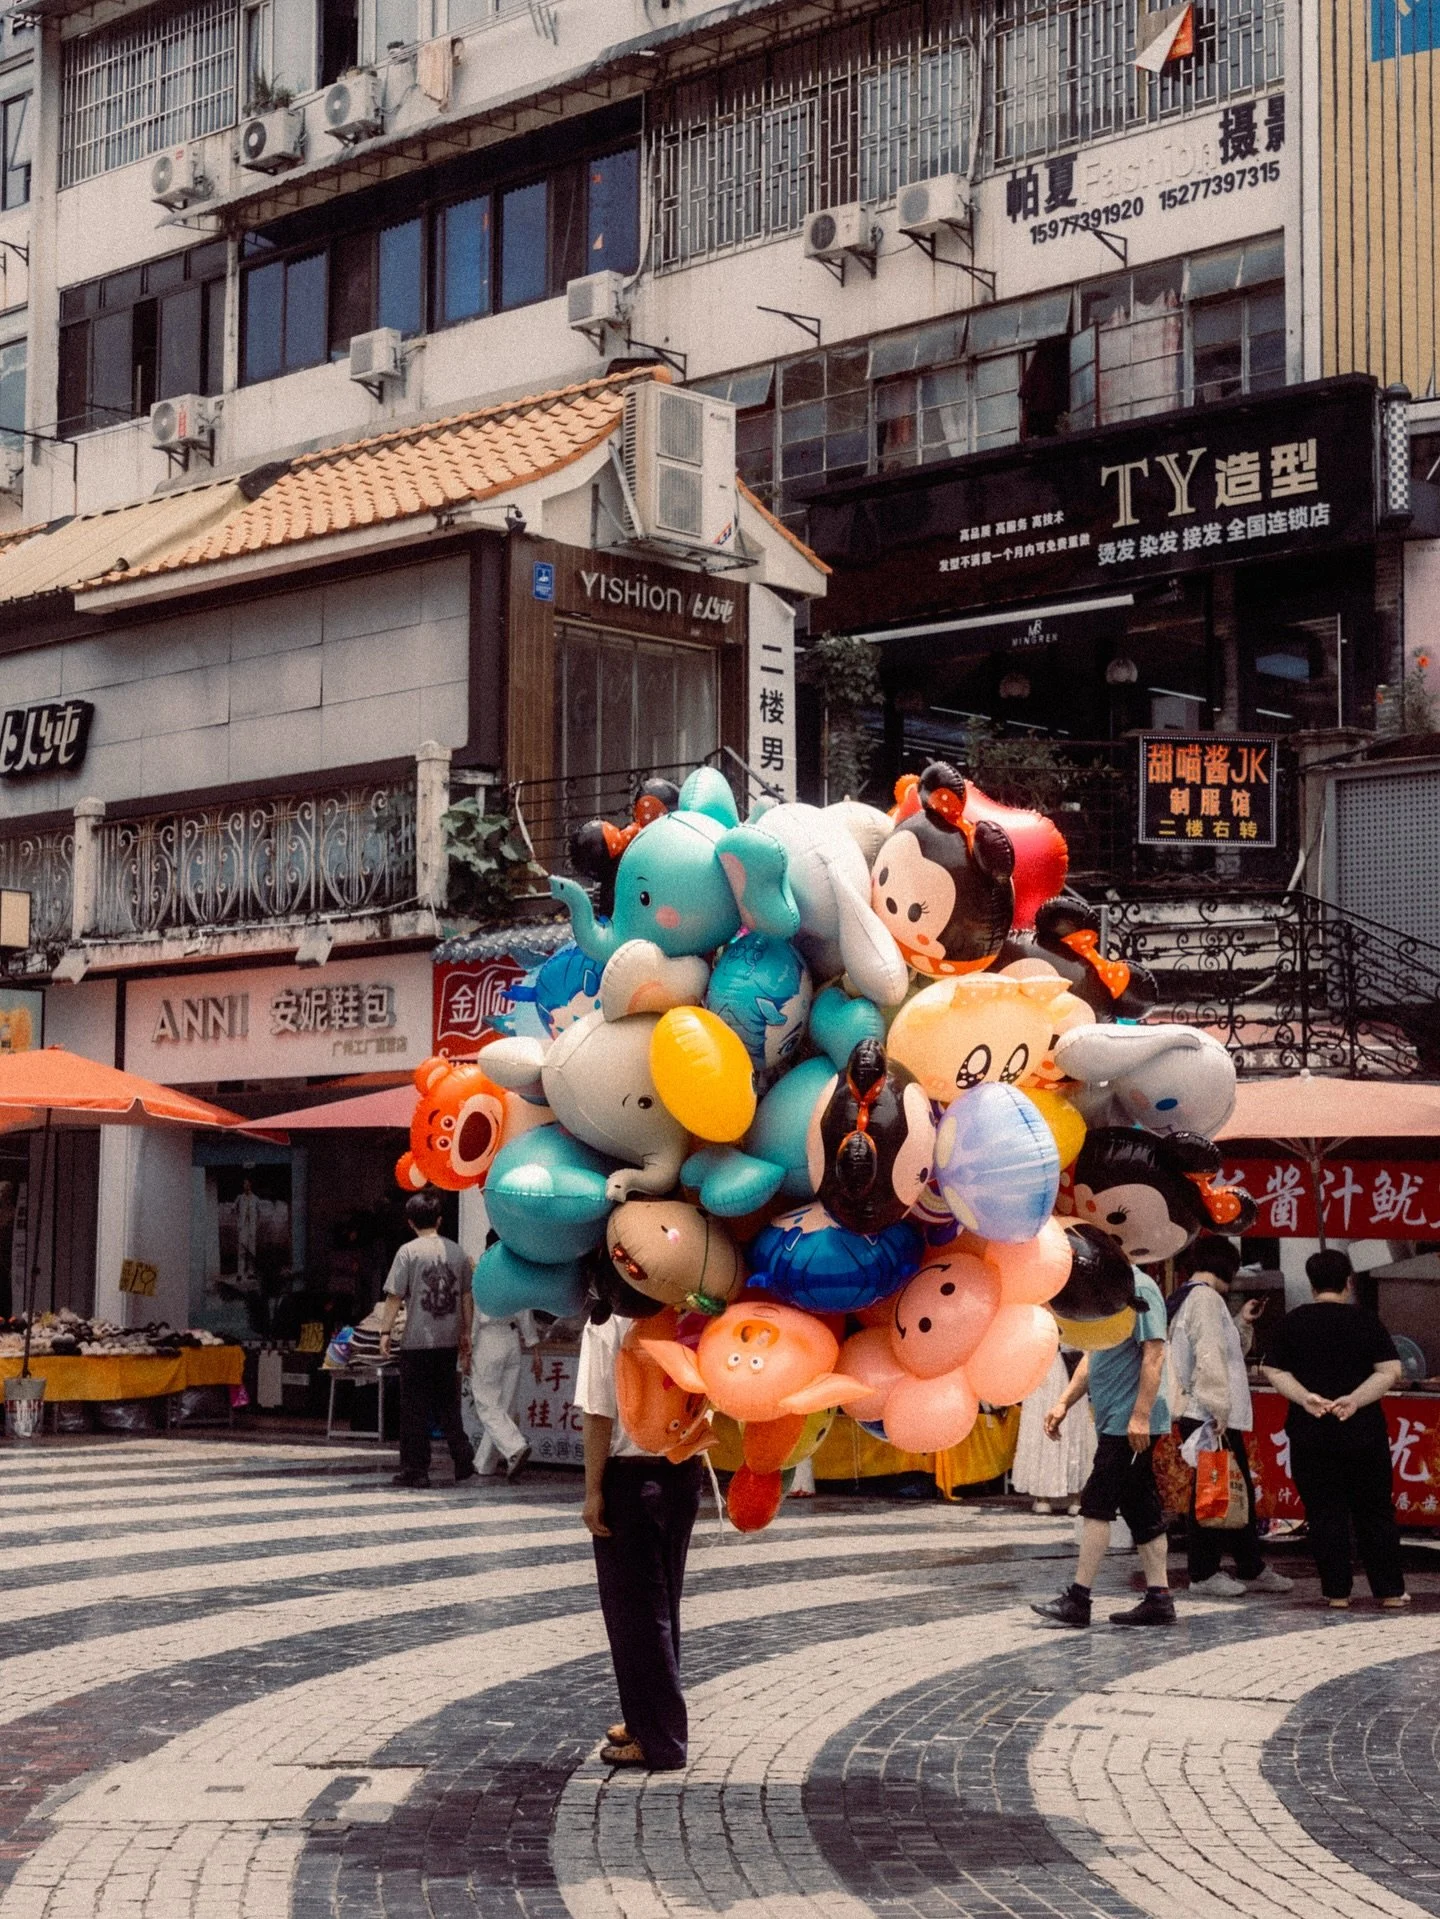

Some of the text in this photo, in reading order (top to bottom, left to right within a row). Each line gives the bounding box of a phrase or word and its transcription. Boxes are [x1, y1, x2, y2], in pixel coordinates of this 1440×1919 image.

[1030, 160, 1280, 245] 15977391920 15277397315
[1139, 531, 1179, 558] 染发
[1182, 522, 1222, 551] 接发
[1226, 502, 1331, 543] 全国连锁店
[1158, 819, 1258, 838] 二楼右转
[151, 985, 395, 1042] ANNI 安妮鞋包
